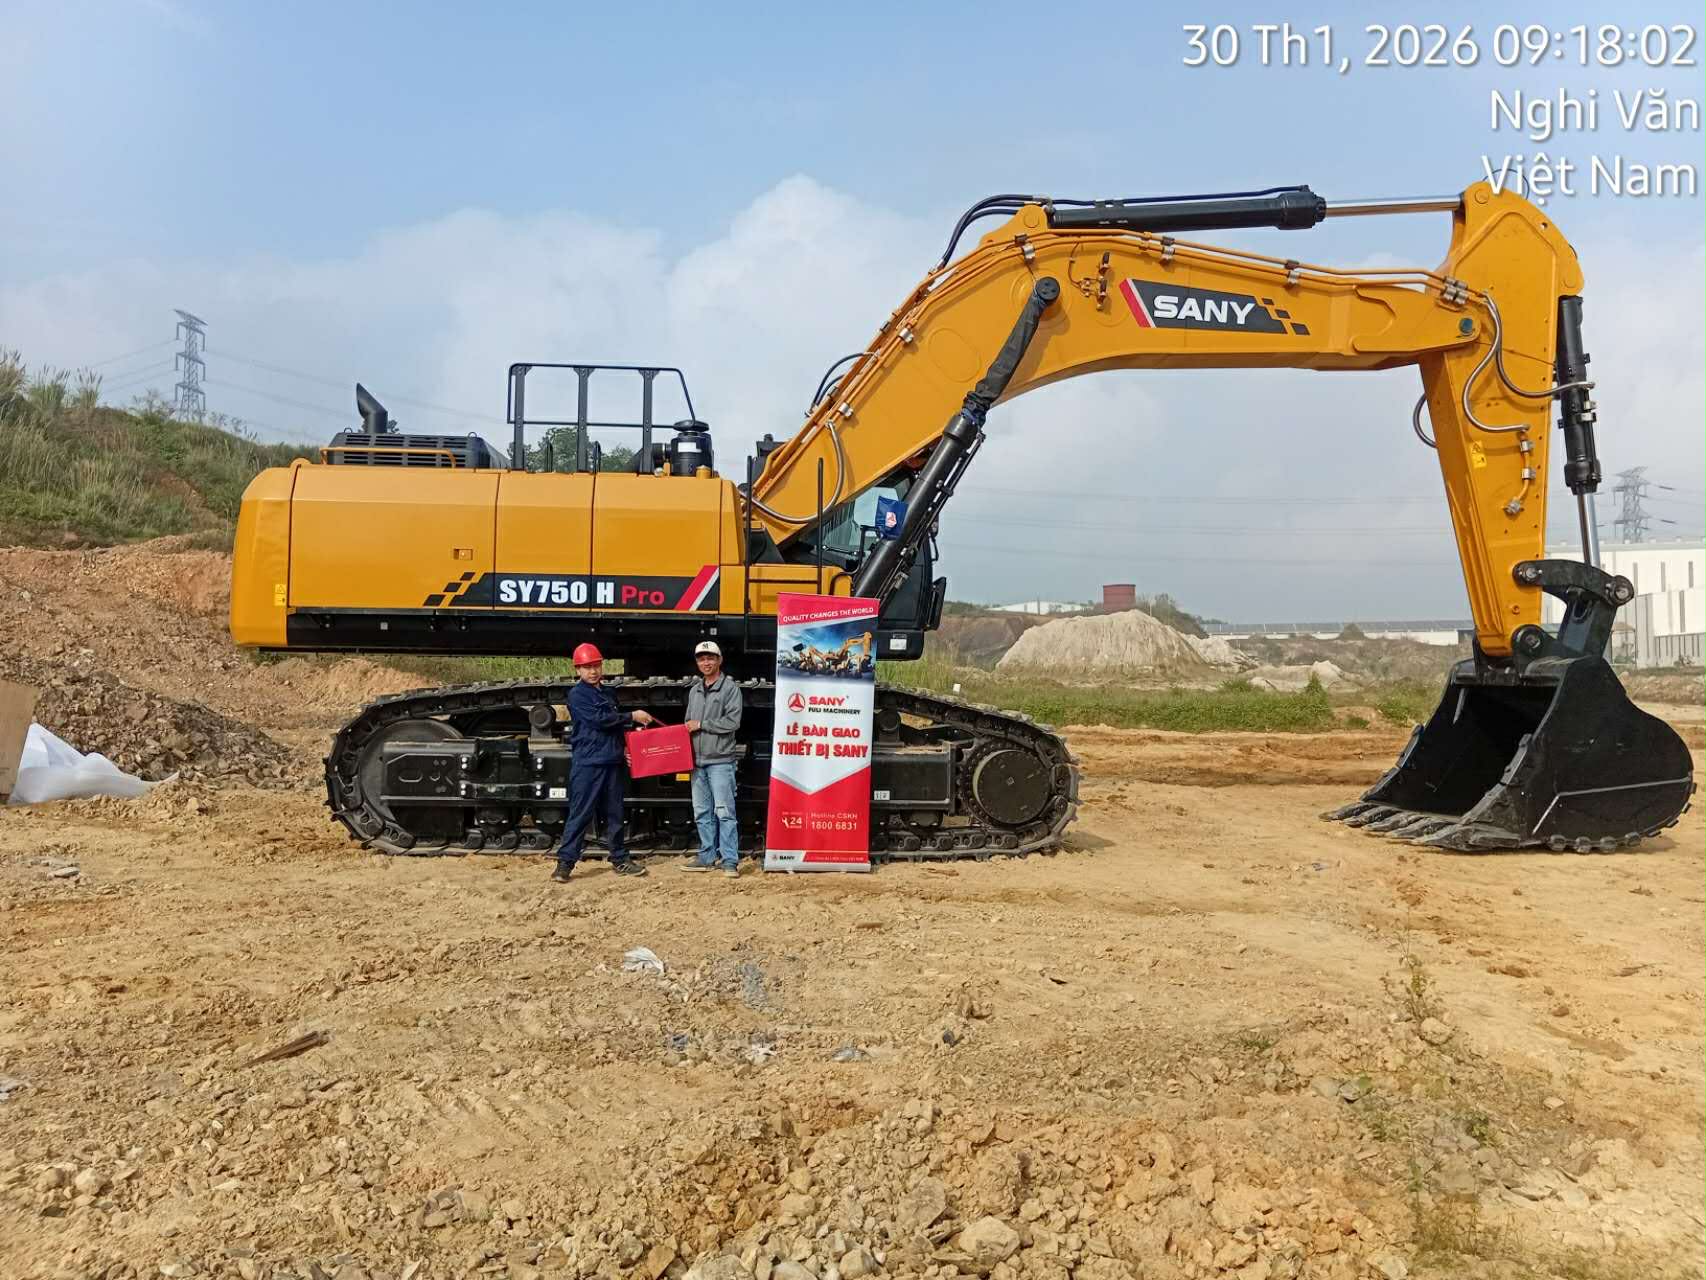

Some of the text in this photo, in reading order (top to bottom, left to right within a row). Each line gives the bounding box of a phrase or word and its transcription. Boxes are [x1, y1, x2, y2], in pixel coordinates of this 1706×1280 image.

[1154, 295, 1255, 325] SANY
[500, 580, 665, 605] SY750 H Pro
[783, 613, 809, 622] QUALITY
[809, 610, 838, 619] CHANGES
[852, 607, 874, 615] WORLD
[809, 696, 845, 706] SANY
[802, 725, 828, 737] BÀN
[832, 728, 860, 738] GIAO
[778, 739, 868, 759] THIẾT BỊ SANY
[835, 821, 857, 830] 6831
